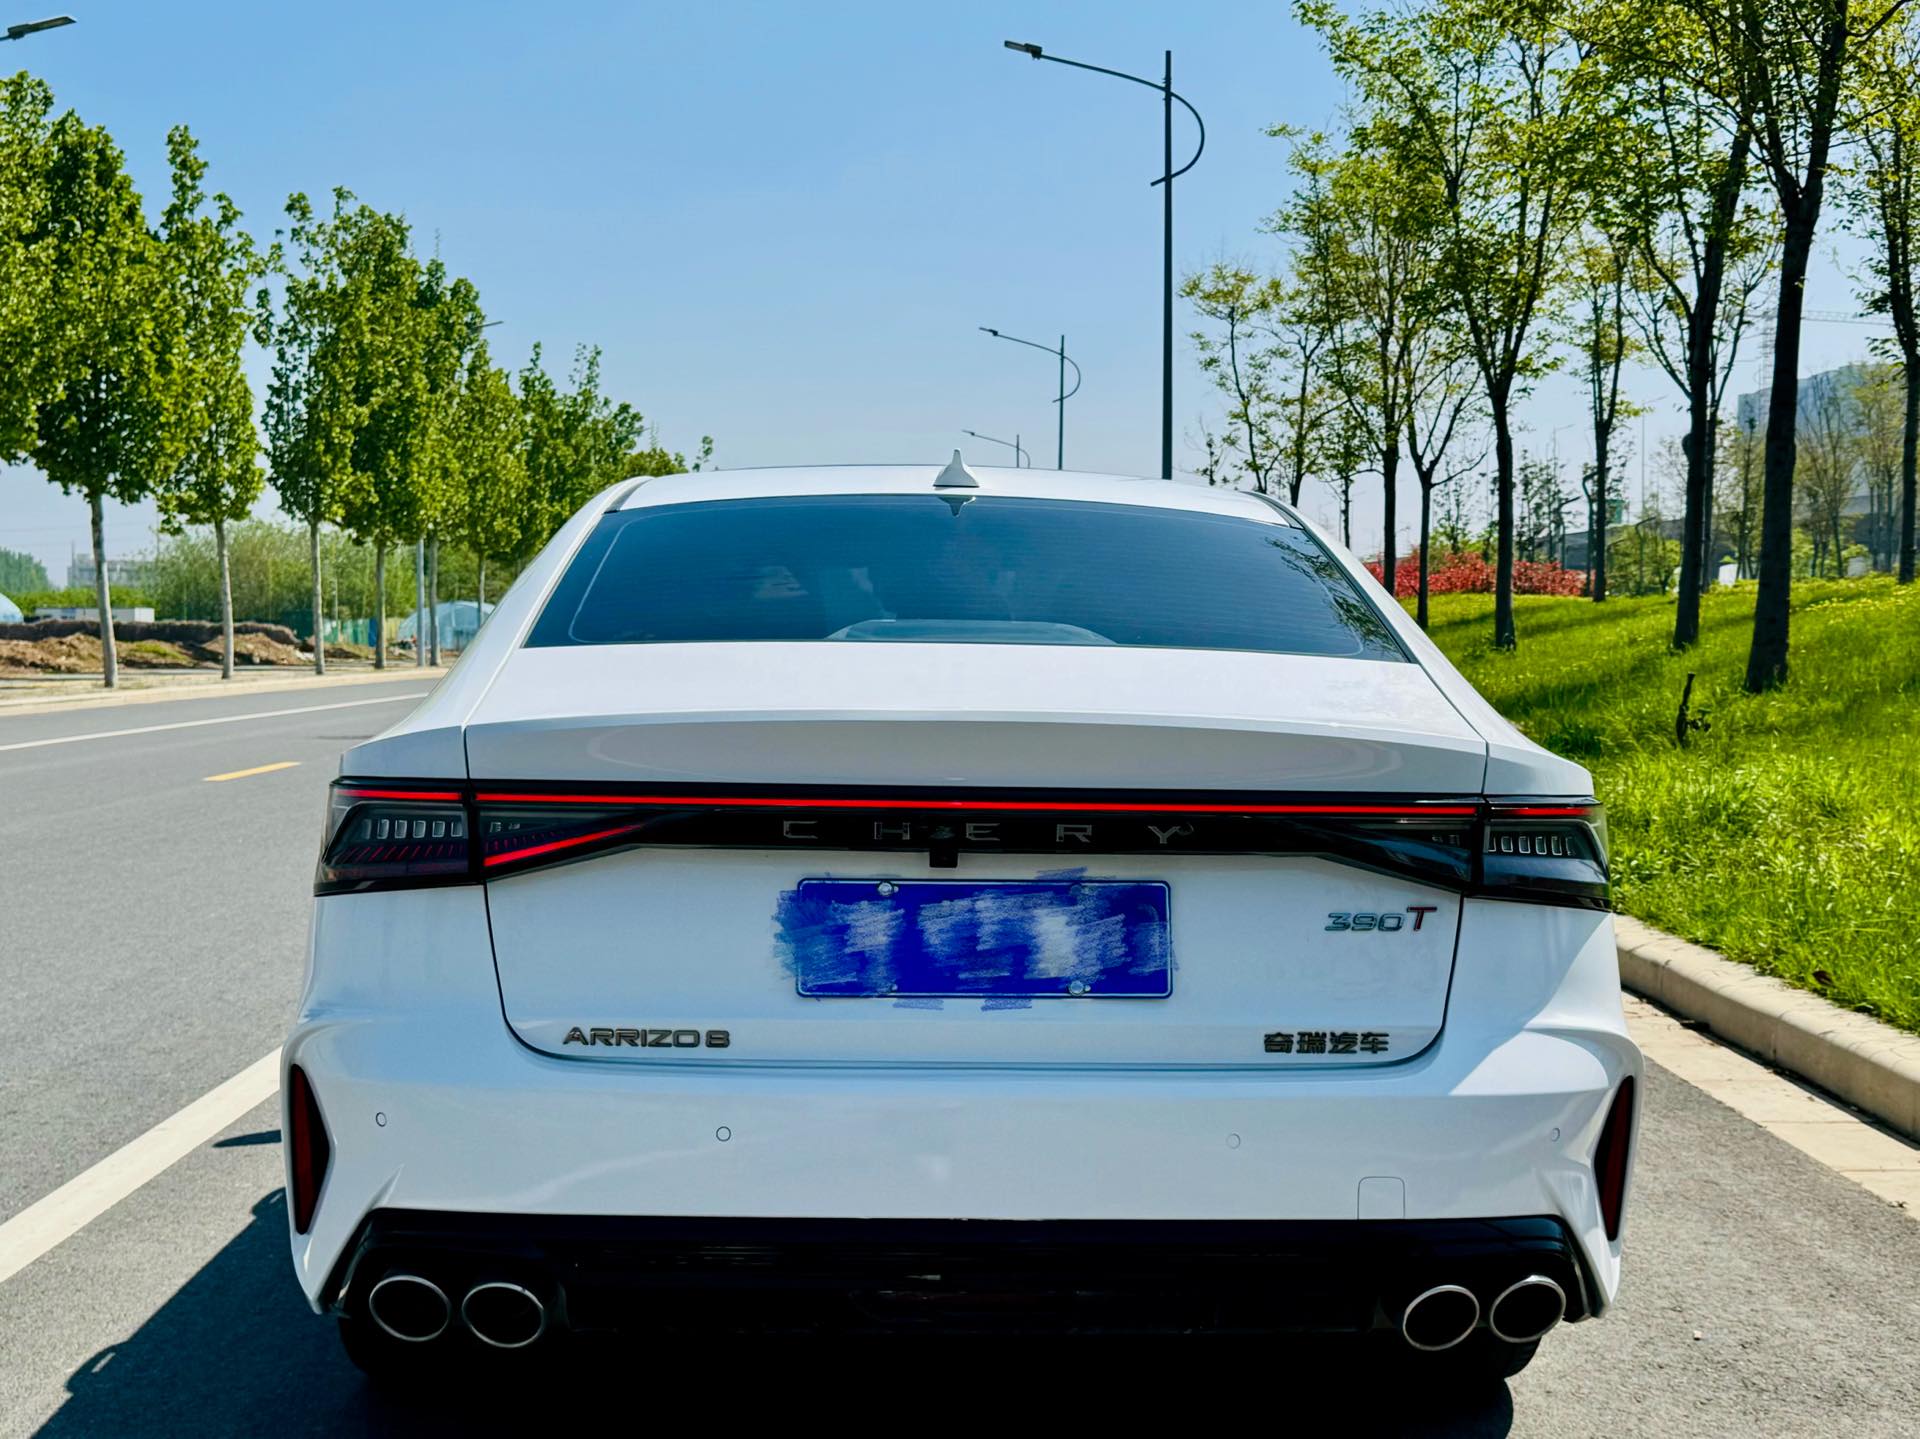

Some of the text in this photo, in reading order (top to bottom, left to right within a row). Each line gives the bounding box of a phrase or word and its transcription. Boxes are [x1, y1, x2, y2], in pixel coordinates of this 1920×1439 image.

[783, 820, 1181, 844] CHERY
[1324, 906, 1438, 931] 390T
[1264, 1031, 1390, 1054] 奇瑞汽车
